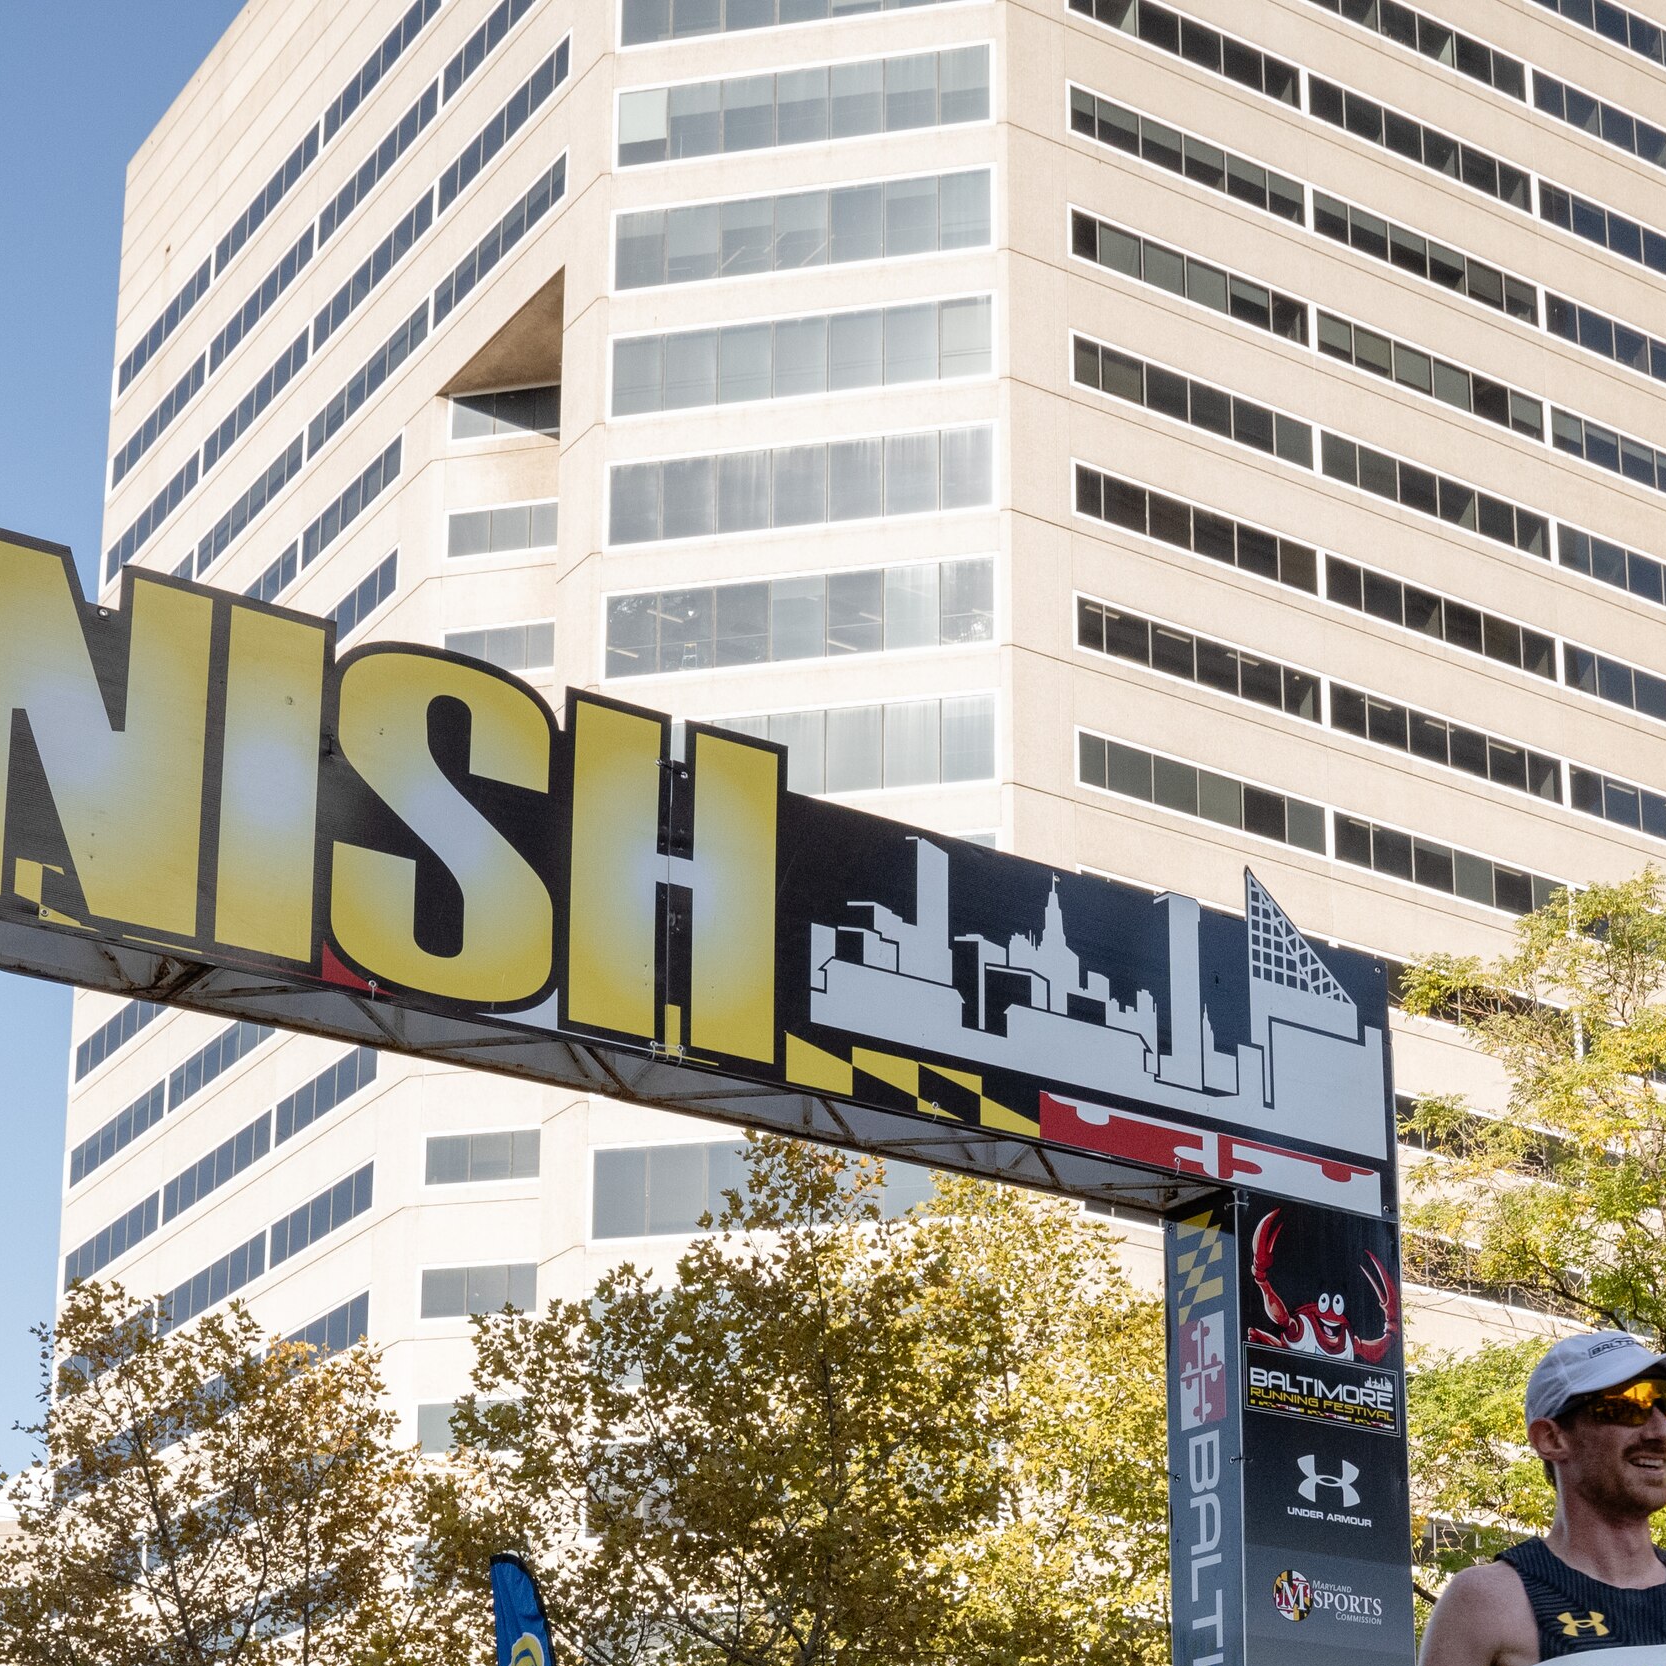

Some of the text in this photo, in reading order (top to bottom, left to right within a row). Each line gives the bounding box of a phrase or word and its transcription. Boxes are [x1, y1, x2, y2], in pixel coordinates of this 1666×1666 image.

[1249, 1366, 1394, 1411] BALTIMORE
[1250, 1387, 1395, 1422] RUNNING FESTIVAL
[1287, 1506, 1372, 1528] UNDER ARMOUR
[1313, 1590, 1383, 1617] SPORTS
